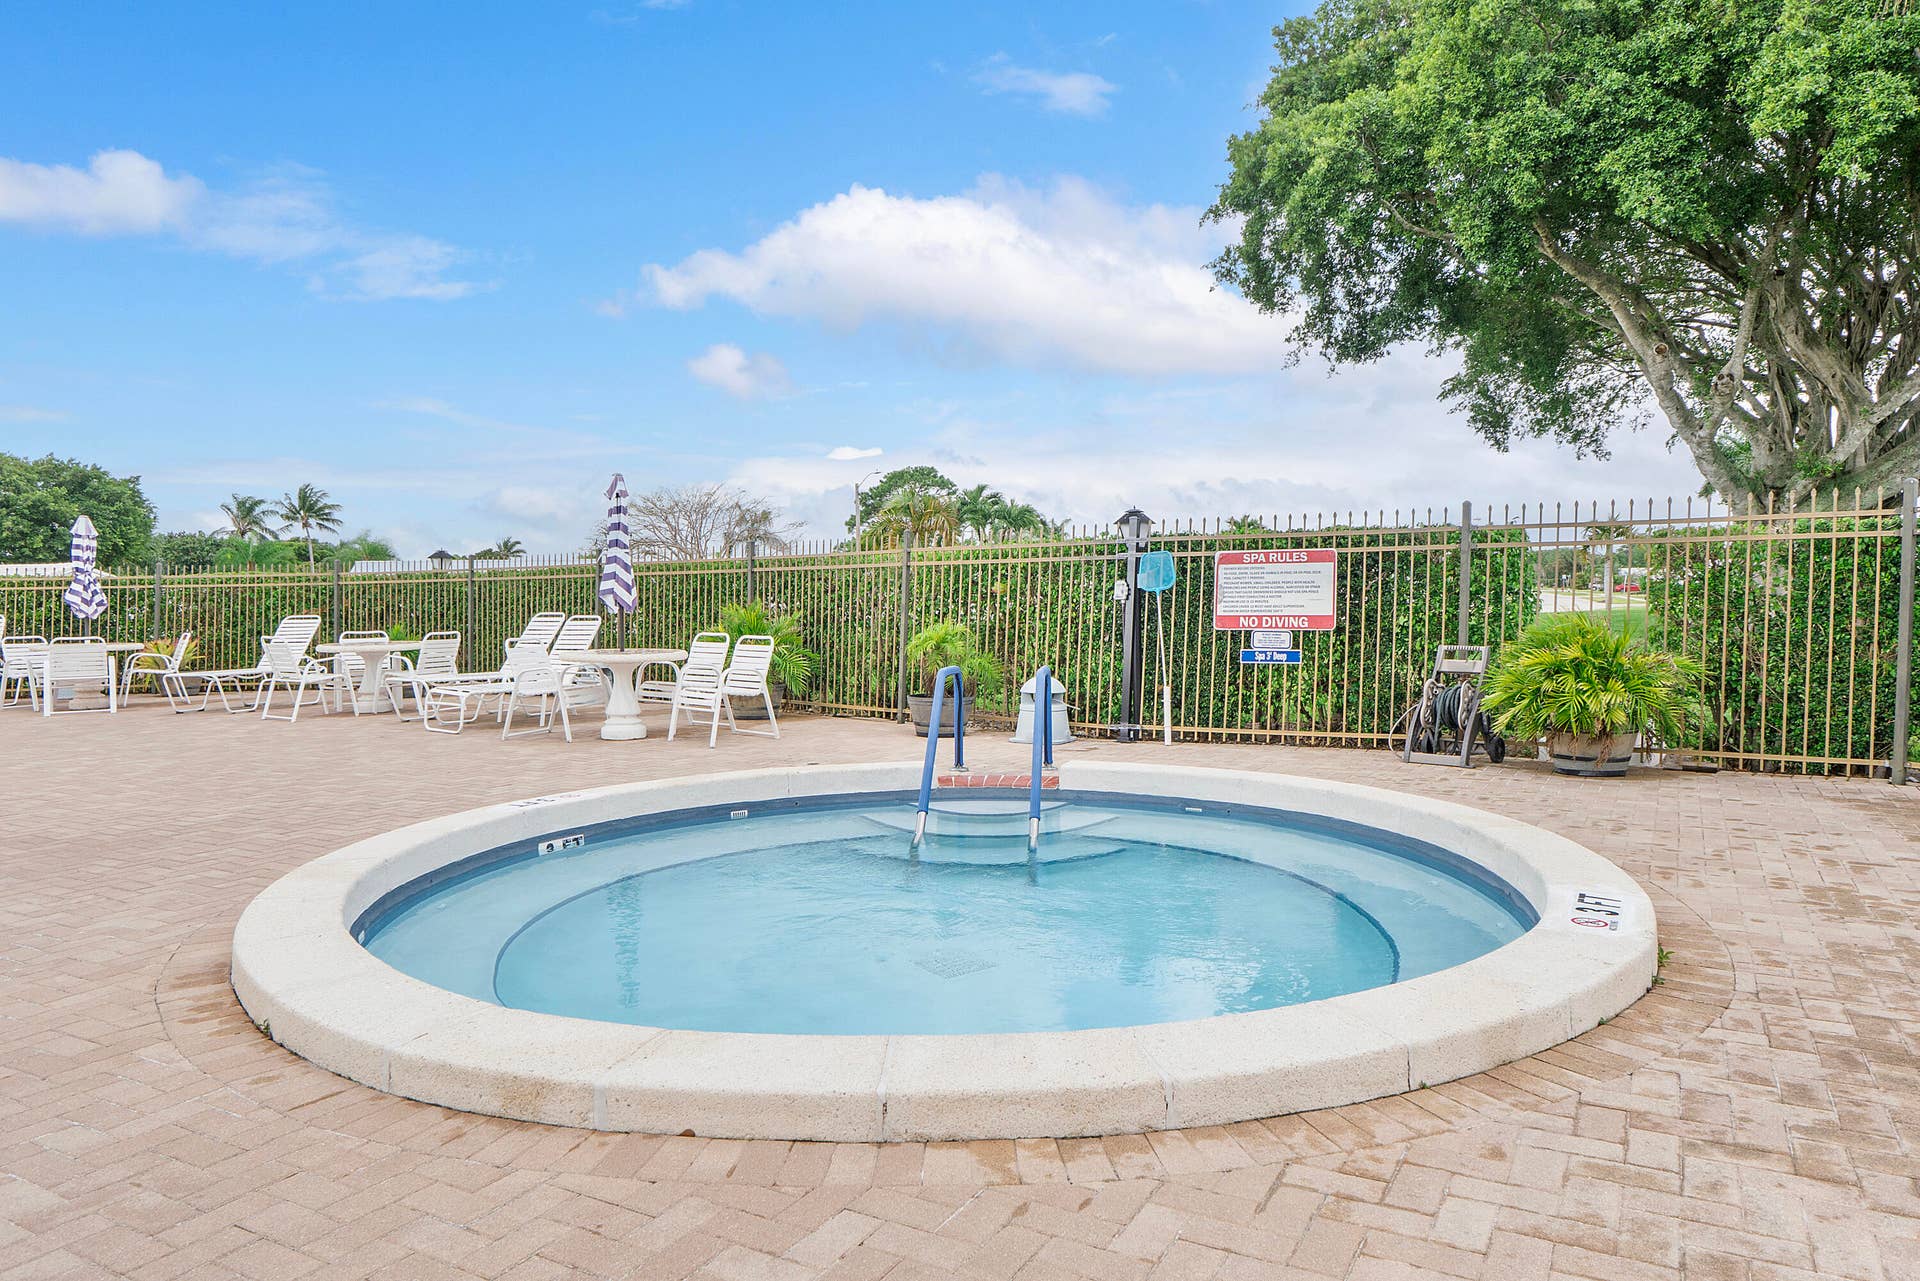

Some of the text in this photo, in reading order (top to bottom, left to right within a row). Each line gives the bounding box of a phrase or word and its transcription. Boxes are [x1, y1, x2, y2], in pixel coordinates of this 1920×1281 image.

[1243, 552, 1308, 563] SPA RULES
[1239, 616, 1309, 628] NO DIVING
[1254, 651, 1265, 662] Spa
[1273, 651, 1287, 663] Deep
[1575, 893, 1622, 916] 3 FT
